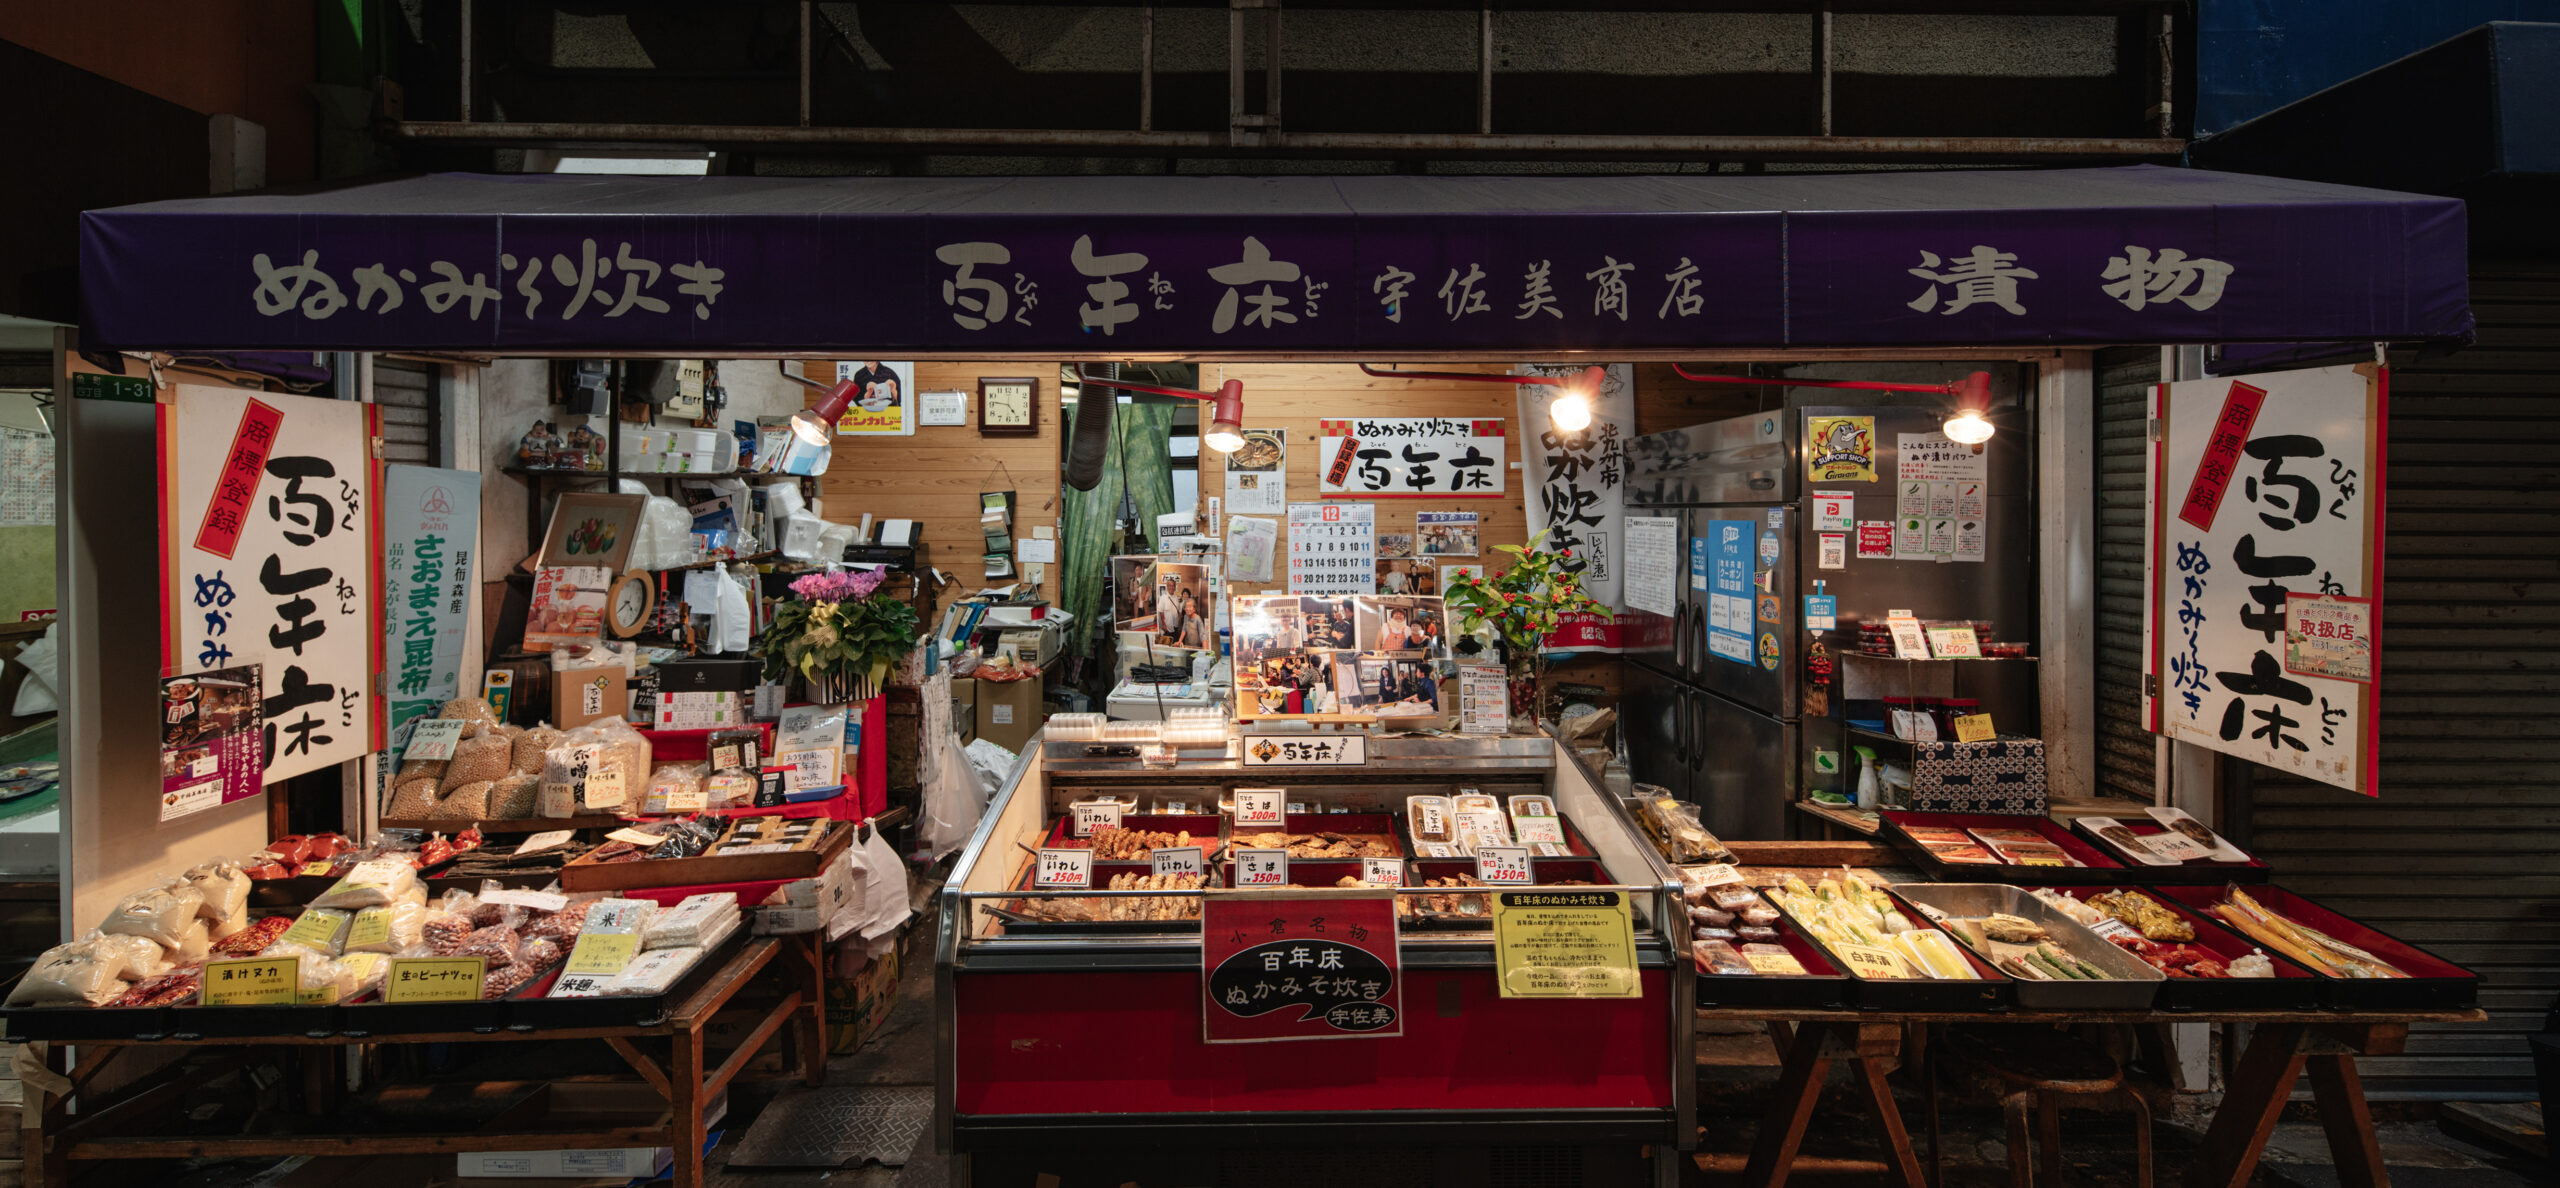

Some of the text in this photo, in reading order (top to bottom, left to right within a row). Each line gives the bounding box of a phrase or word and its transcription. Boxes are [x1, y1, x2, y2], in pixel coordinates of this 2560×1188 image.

[936, 234, 1301, 335] 百年床
[1373, 255, 1705, 323] 宇佐美商店
[1907, 245, 2235, 315] 漬物
[113, 381, 152, 399] 1-31
[840, 416, 903, 426] ボンカレー
[1357, 417, 1470, 437] ぬかみそ炊き
[1599, 421, 1623, 491] 北九州市
[1818, 453, 1867, 465] SUPPORT SHOP
[1911, 451, 1974, 462] ぬか漬けパワー
[2190, 403, 2252, 513] 商標登録
[1356, 444, 1495, 491] 百年床
[207, 419, 270, 535] 商標登録
[2329, 458, 2358, 521] ひゃく
[340, 479, 359, 531] ひゃく
[1325, 508, 1337, 519] 12
[1329, 527, 1367, 535] 1 2 3 4
[389, 542, 403, 570] 品名
[1295, 543, 1369, 551] 5 6 7 8 9 10 11
[1293, 559, 1370, 567] 12 13 14 15 16 17 18
[450, 550, 468, 615] 昆布森産
[1293, 575, 1370, 583] 19 20 21 22 23 24 25
[1719, 568, 1742, 580] クーポン
[535, 569, 555, 609] 太陽卵
[2215, 434, 2325, 753] 百年床
[2319, 571, 2346, 599] ね
[336, 577, 356, 614] ねん
[260, 456, 336, 772] 百年床
[398, 534, 446, 696] さおまえ昆布
[2299, 618, 2355, 641] 取扱店
[340, 687, 360, 727] どこ
[2319, 696, 2348, 746] どこ
[1282, 741, 1332, 761] 百年床
[1246, 801, 1271, 810] さば
[1084, 814, 1111, 823] いわし
[1250, 811, 1276, 820] 300円
[1047, 859, 1079, 872] いわし
[1162, 860, 1192, 871] いわし
[1247, 862, 1275, 872] さば
[1482, 860, 1497, 868] 辛口
[1052, 872, 1083, 883] 350円
[1252, 873, 1281, 883] 350円
[1376, 875, 1398, 883] 150円
[1493, 870, 1526, 880] 350円
[1513, 895, 1606, 905] 百年床のぬかみそ炊き
[600, 912, 615, 927] 米
[1230, 916, 1369, 944] 小倉名物
[1259, 946, 1345, 971] 百年床
[1850, 951, 1892, 967] 白菜漬
[222, 967, 278, 980] 漬けヌカ
[401, 969, 474, 982] 生のピーナツです
[1226, 975, 1382, 1005] ぬかみそ炊き
[1330, 1007, 1391, 1025] 宇佐美
